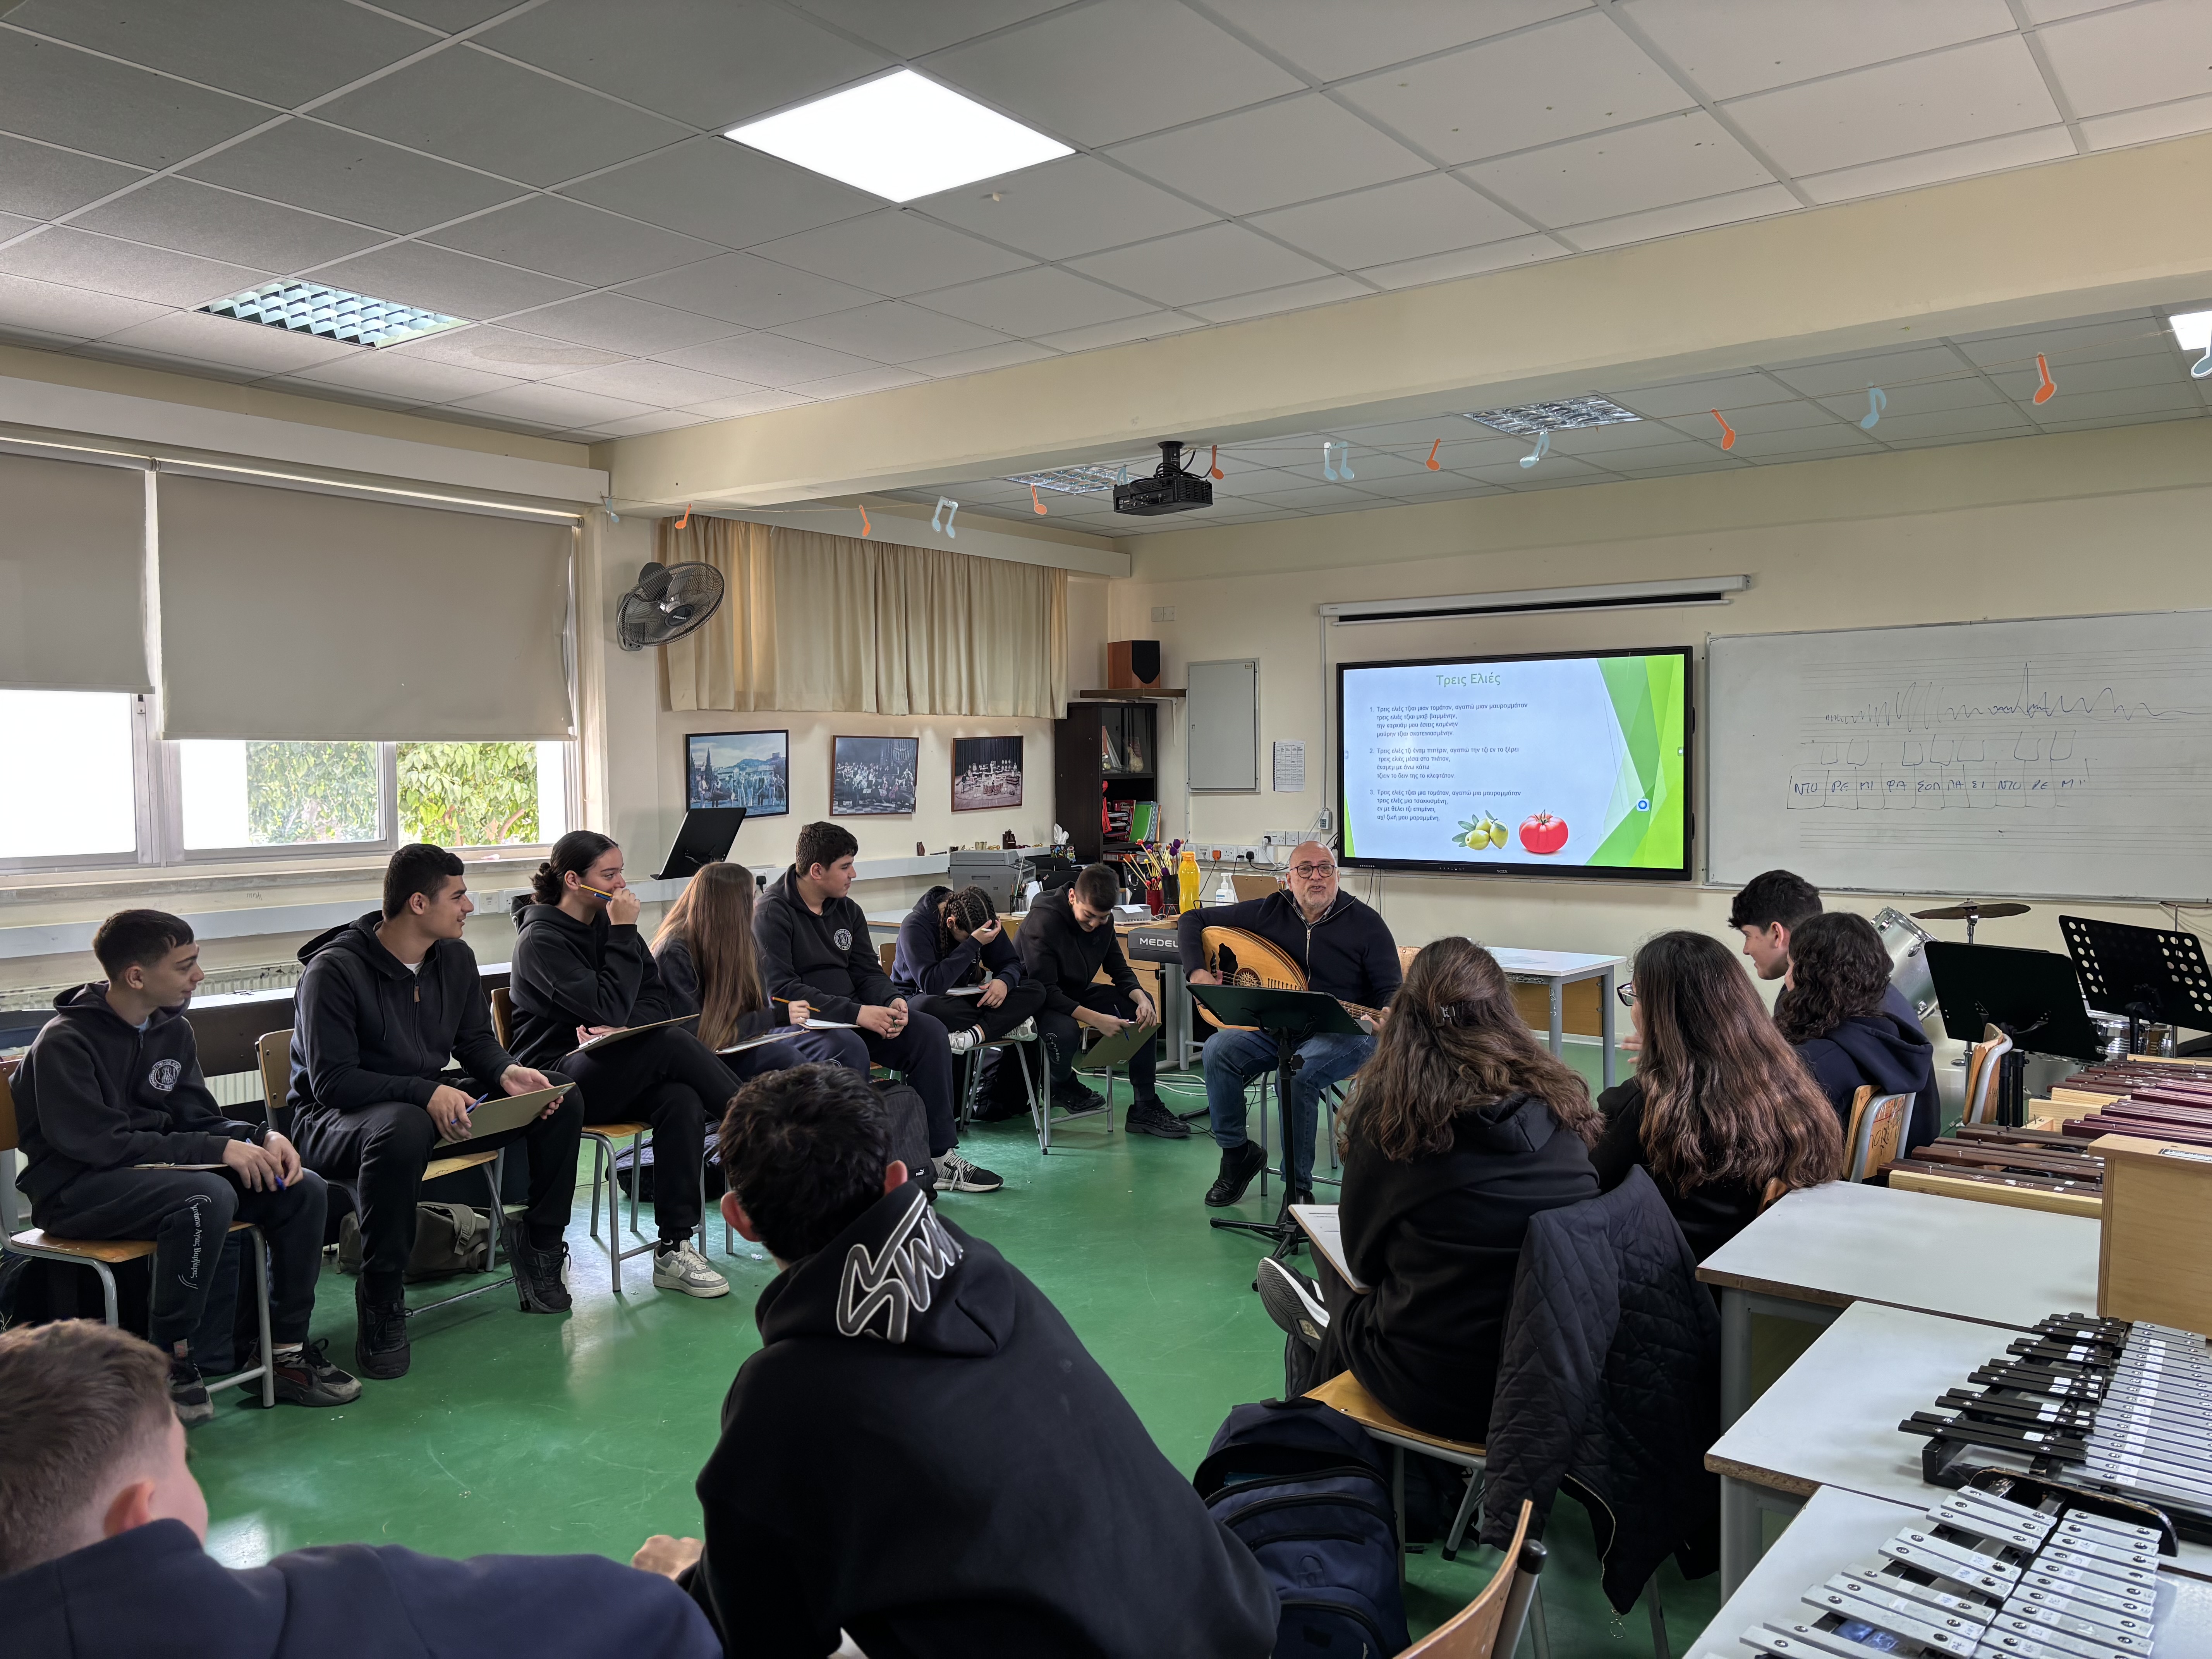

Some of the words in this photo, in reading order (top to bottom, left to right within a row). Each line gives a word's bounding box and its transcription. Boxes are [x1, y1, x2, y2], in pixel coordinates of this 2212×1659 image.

[1436, 674, 1467, 687] Τρεις
[1471, 672, 1501, 685] Ελιές
[1140, 938, 1179, 948] MEDEL
[193, 1229, 202, 1247] Αγίας
